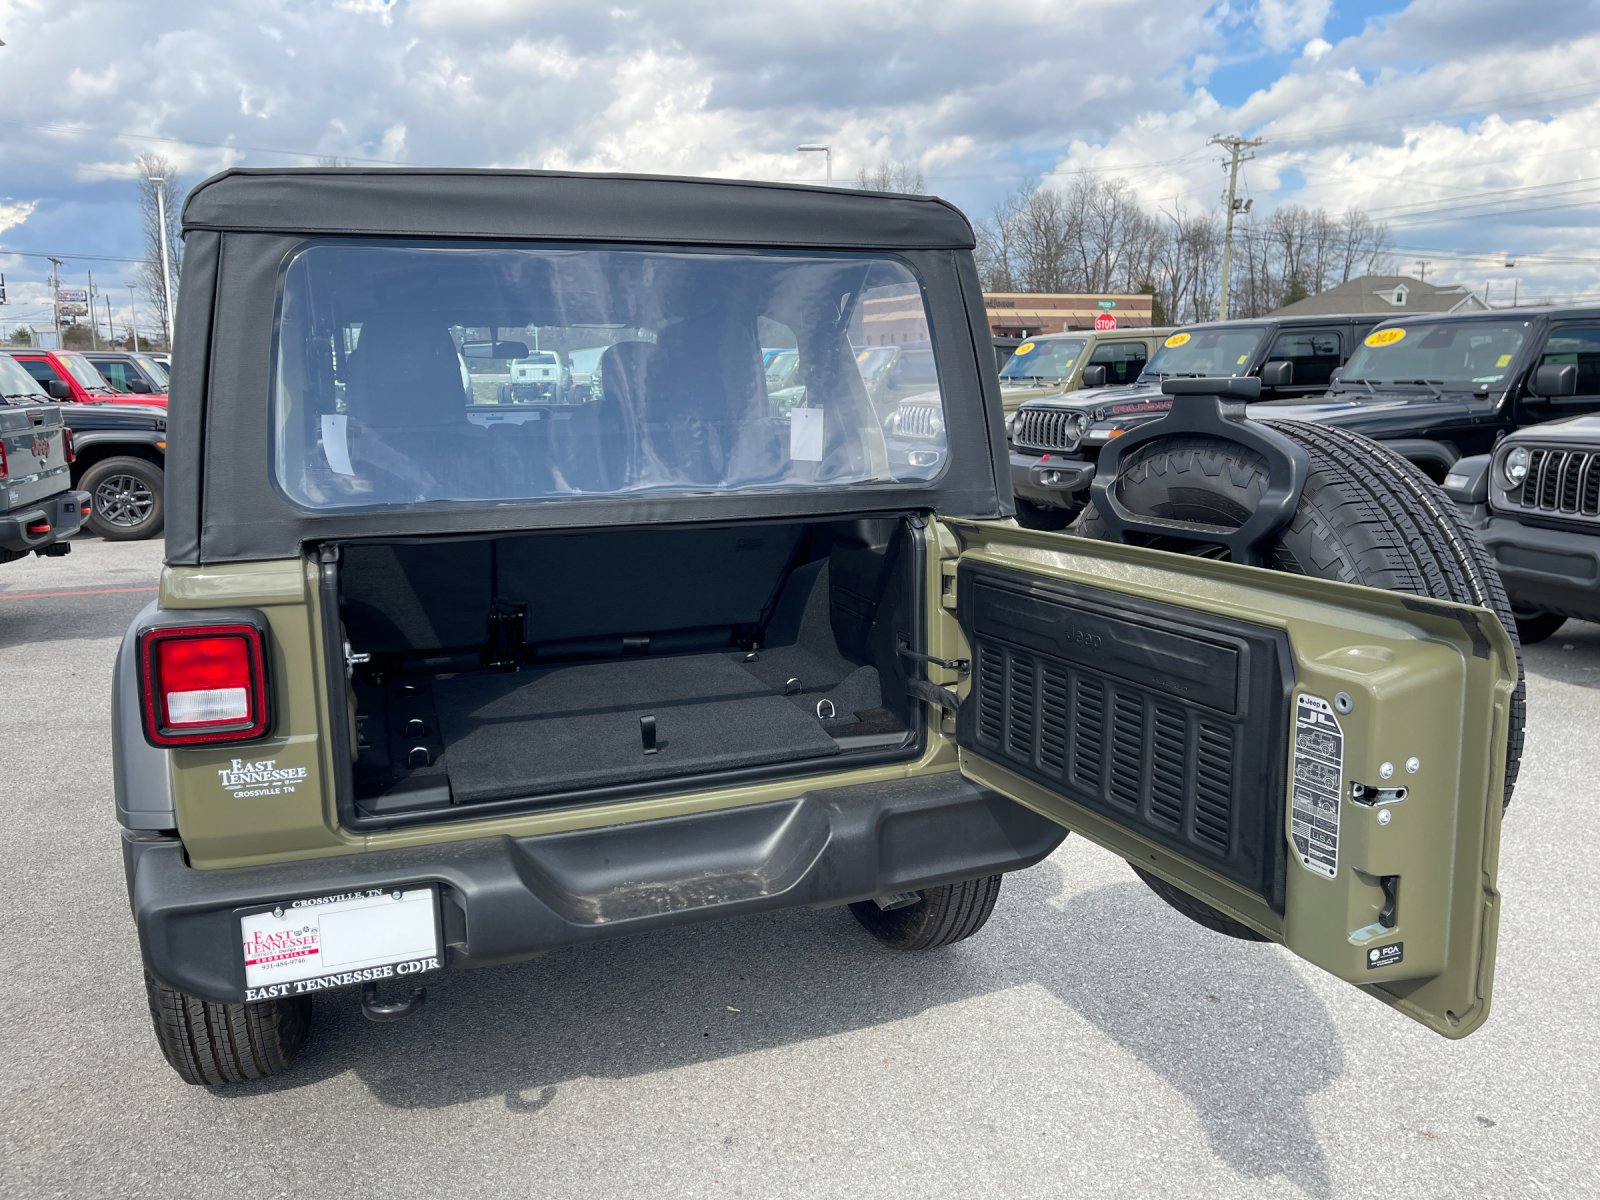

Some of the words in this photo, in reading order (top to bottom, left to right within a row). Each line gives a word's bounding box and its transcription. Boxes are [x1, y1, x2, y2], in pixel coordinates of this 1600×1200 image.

[1096, 319, 1115, 329] STOP
[1305, 698, 1321, 708] Jeep
[230, 758, 276, 774] EAST
[218, 767, 307, 786] TENNESSEE
[233, 787, 281, 798] CROSSVILLE
[291, 891, 365, 908] CROSSVILLE,
[366, 888, 383, 898] TN
[243, 934, 319, 955] TENNESSEE
[253, 930, 293, 945] EAST
[255, 950, 310, 964] CROSSVILLE
[1382, 946, 1399, 956] FCA
[245, 983, 291, 1002] EAST
[294, 965, 393, 993] TENNESSEE
[396, 957, 440, 975] CDJR
